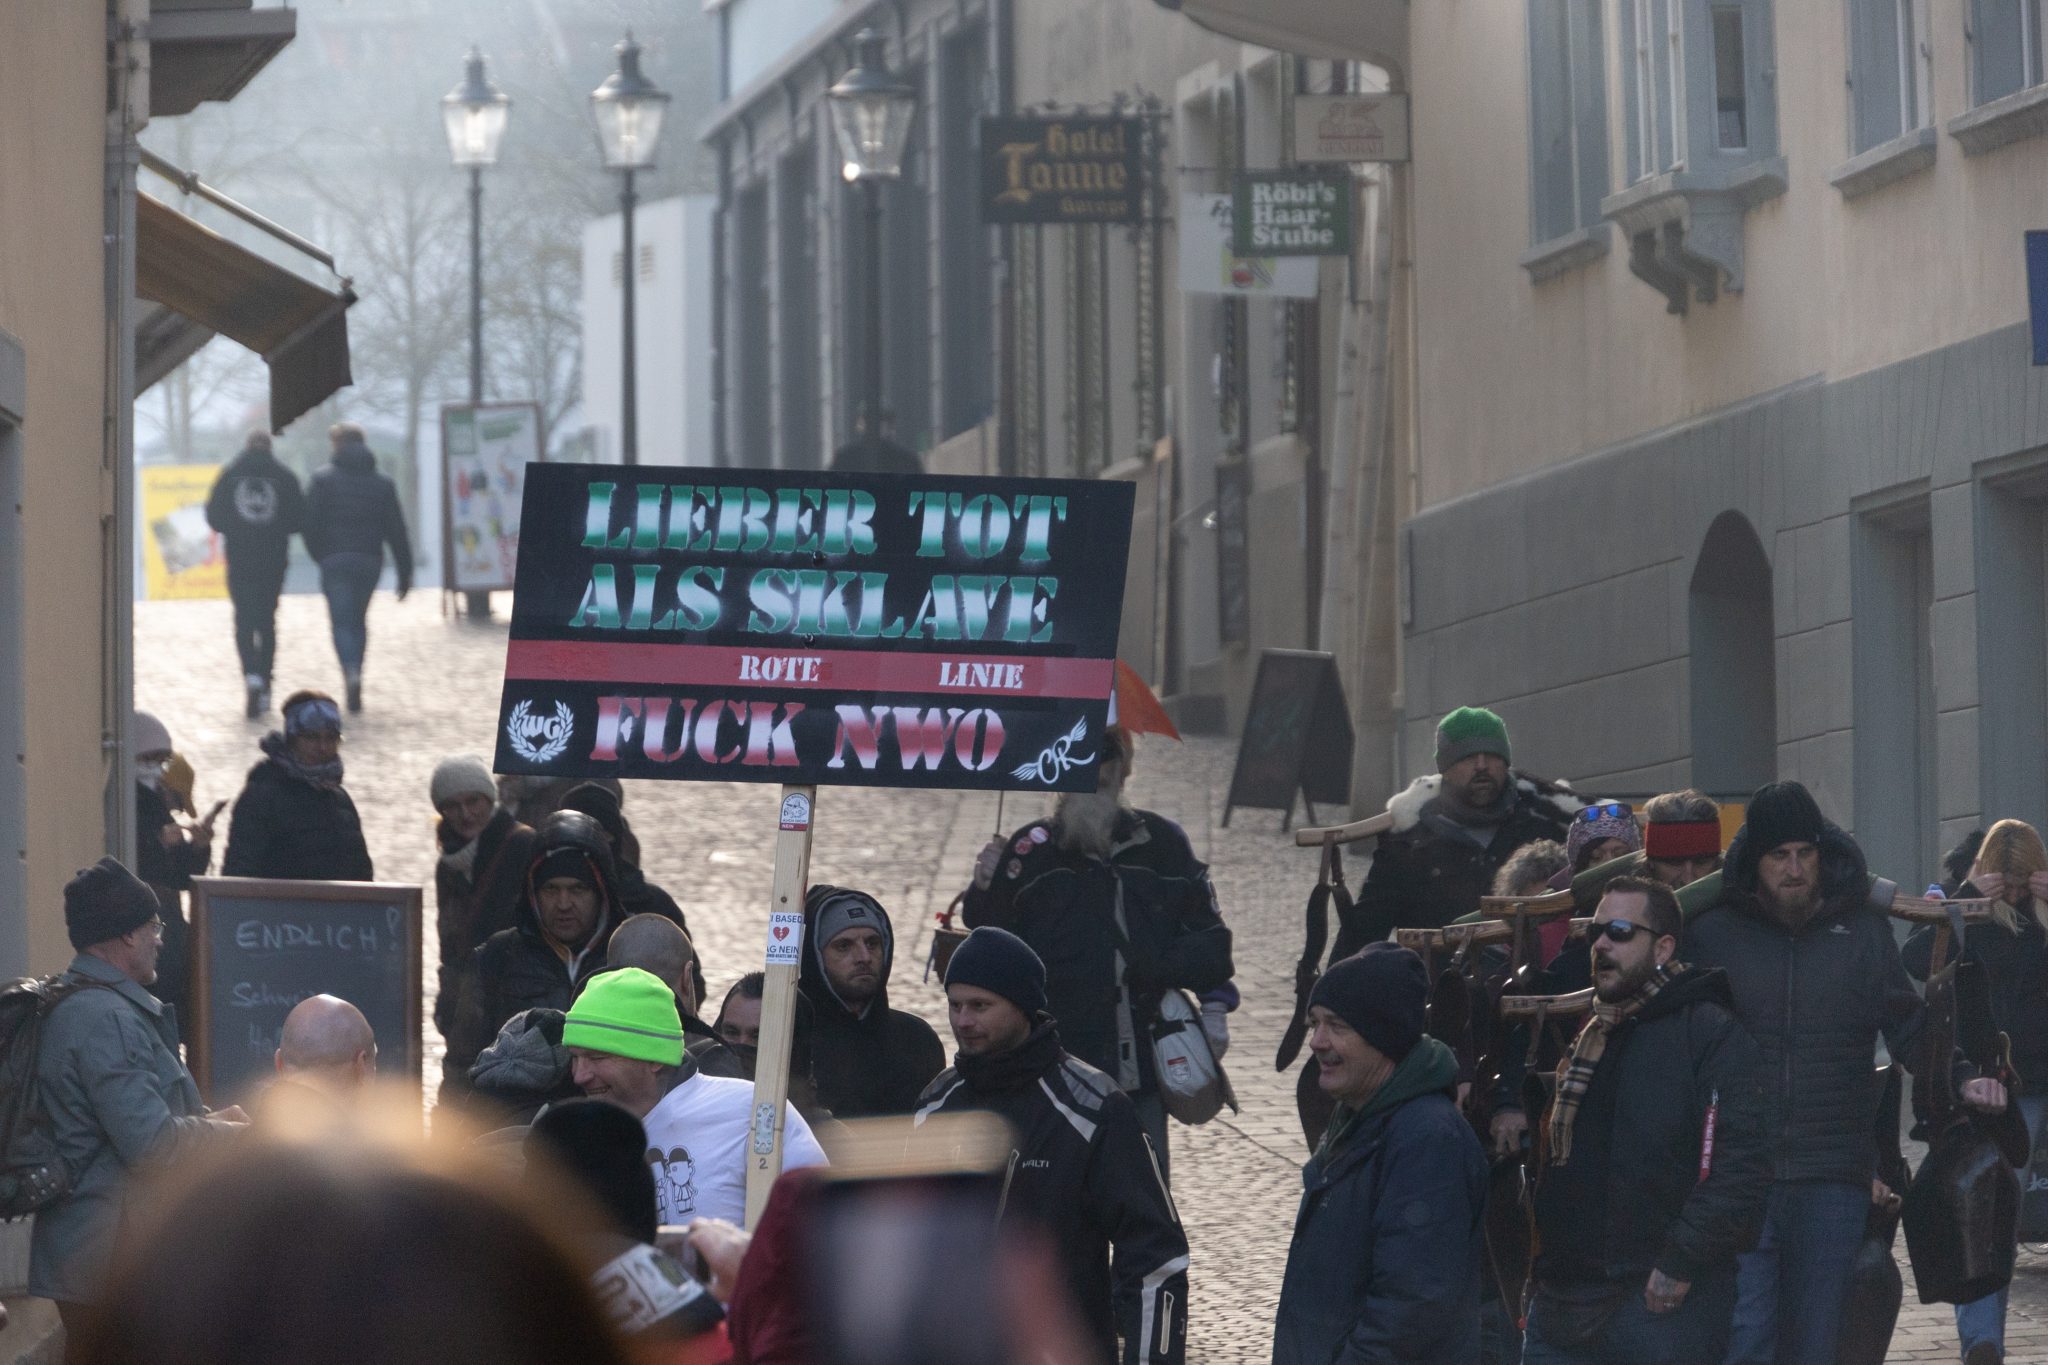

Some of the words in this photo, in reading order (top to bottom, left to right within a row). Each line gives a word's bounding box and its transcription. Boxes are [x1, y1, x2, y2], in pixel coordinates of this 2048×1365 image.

[1047, 123, 1126, 156] Hotel
[991, 142, 1128, 204] Tanne
[1252, 180, 1337, 203] Röbi's
[1252, 203, 1332, 225] Haar-
[1252, 225, 1335, 247] Stube
[580, 481, 878, 554] LIEBER
[908, 490, 1068, 561] TOT
[568, 563, 726, 631] ALS
[747, 566, 1059, 643] SKLAVE
[738, 655, 822, 683] ROTE
[938, 661, 1025, 689] LINIE
[589, 696, 806, 767] FUCK
[826, 704, 1006, 771] NWO
[775, 914, 803, 924] BASED
[778, 945, 800, 955] NEIN
[759, 1157, 769, 1170] 2
